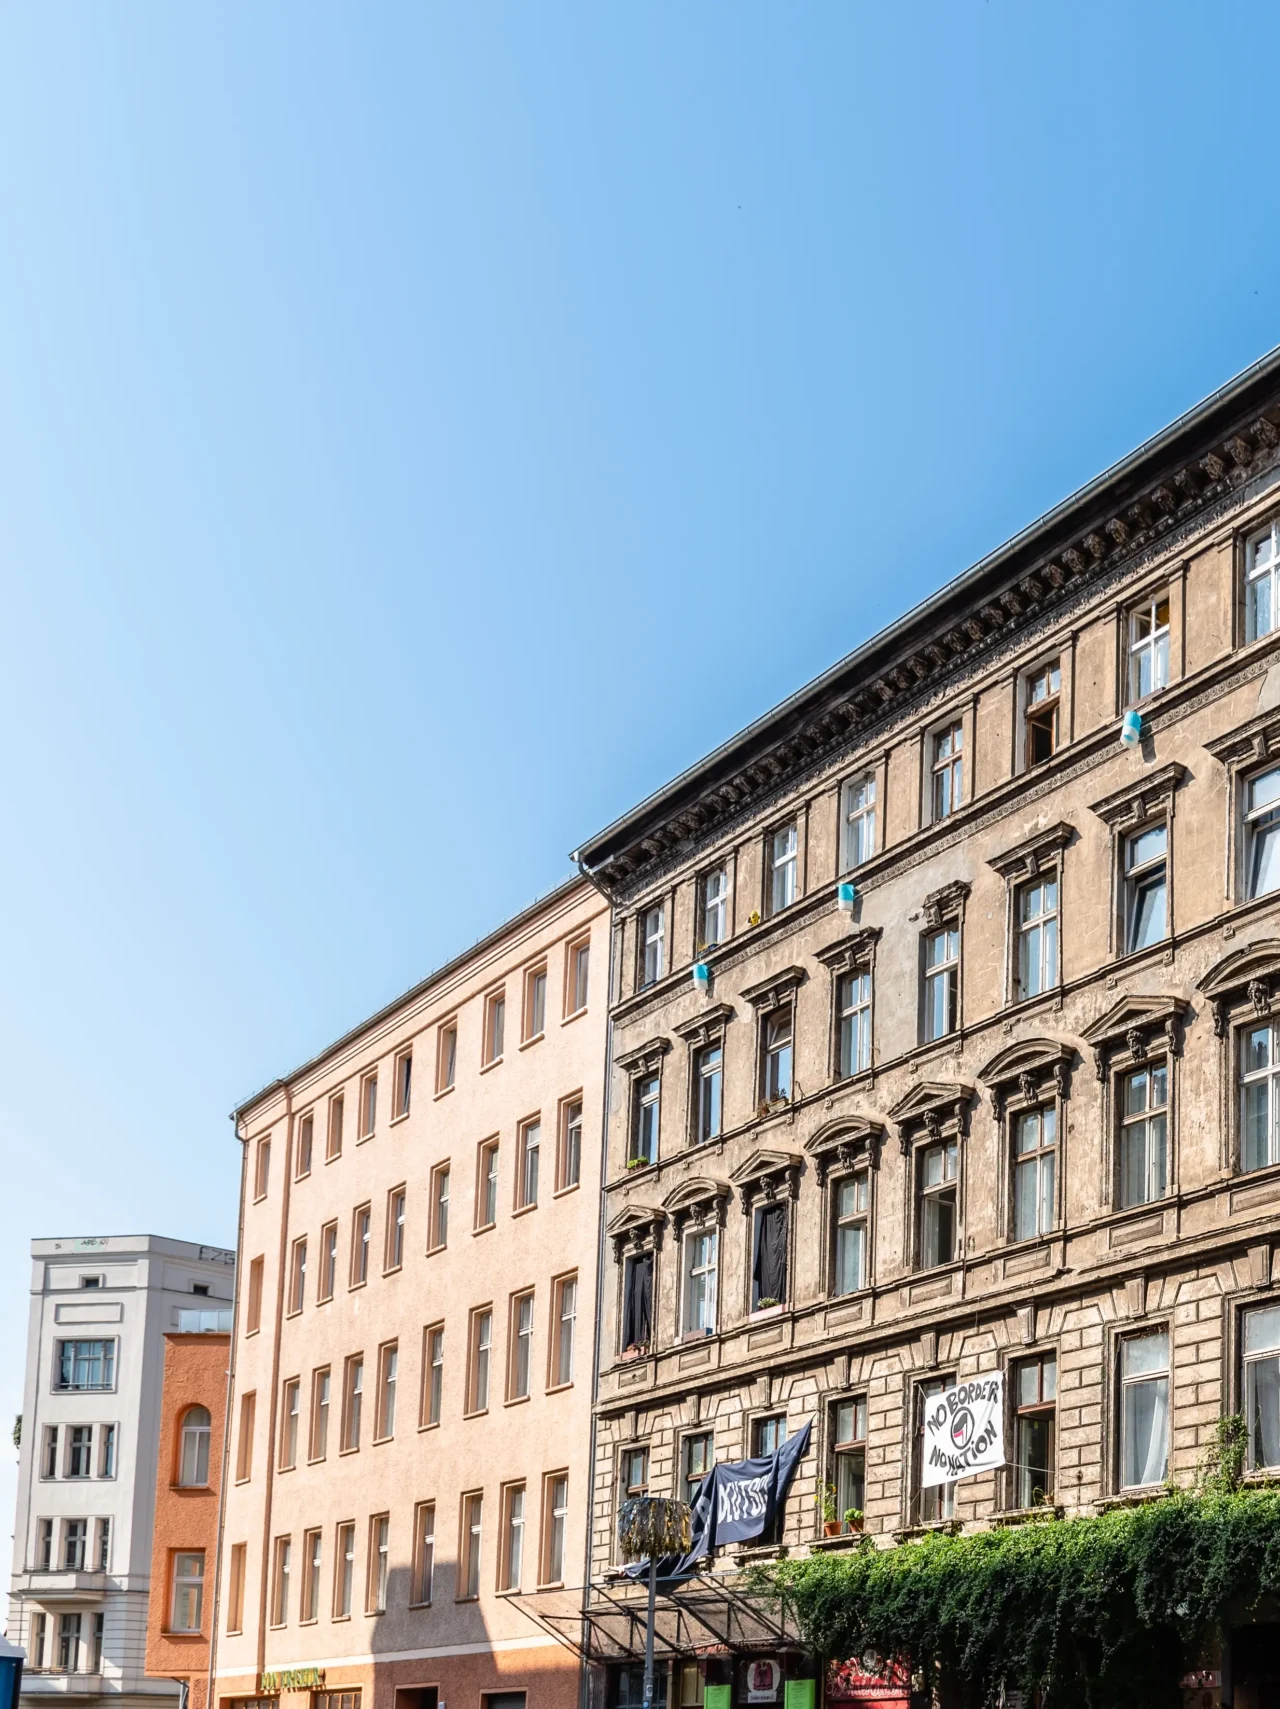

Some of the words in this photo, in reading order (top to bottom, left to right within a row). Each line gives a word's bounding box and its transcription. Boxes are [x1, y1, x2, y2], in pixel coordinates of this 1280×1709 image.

[927, 1403, 948, 1437] NO
[945, 1380, 1000, 1416] BORDER
[928, 1444, 948, 1469] NO
